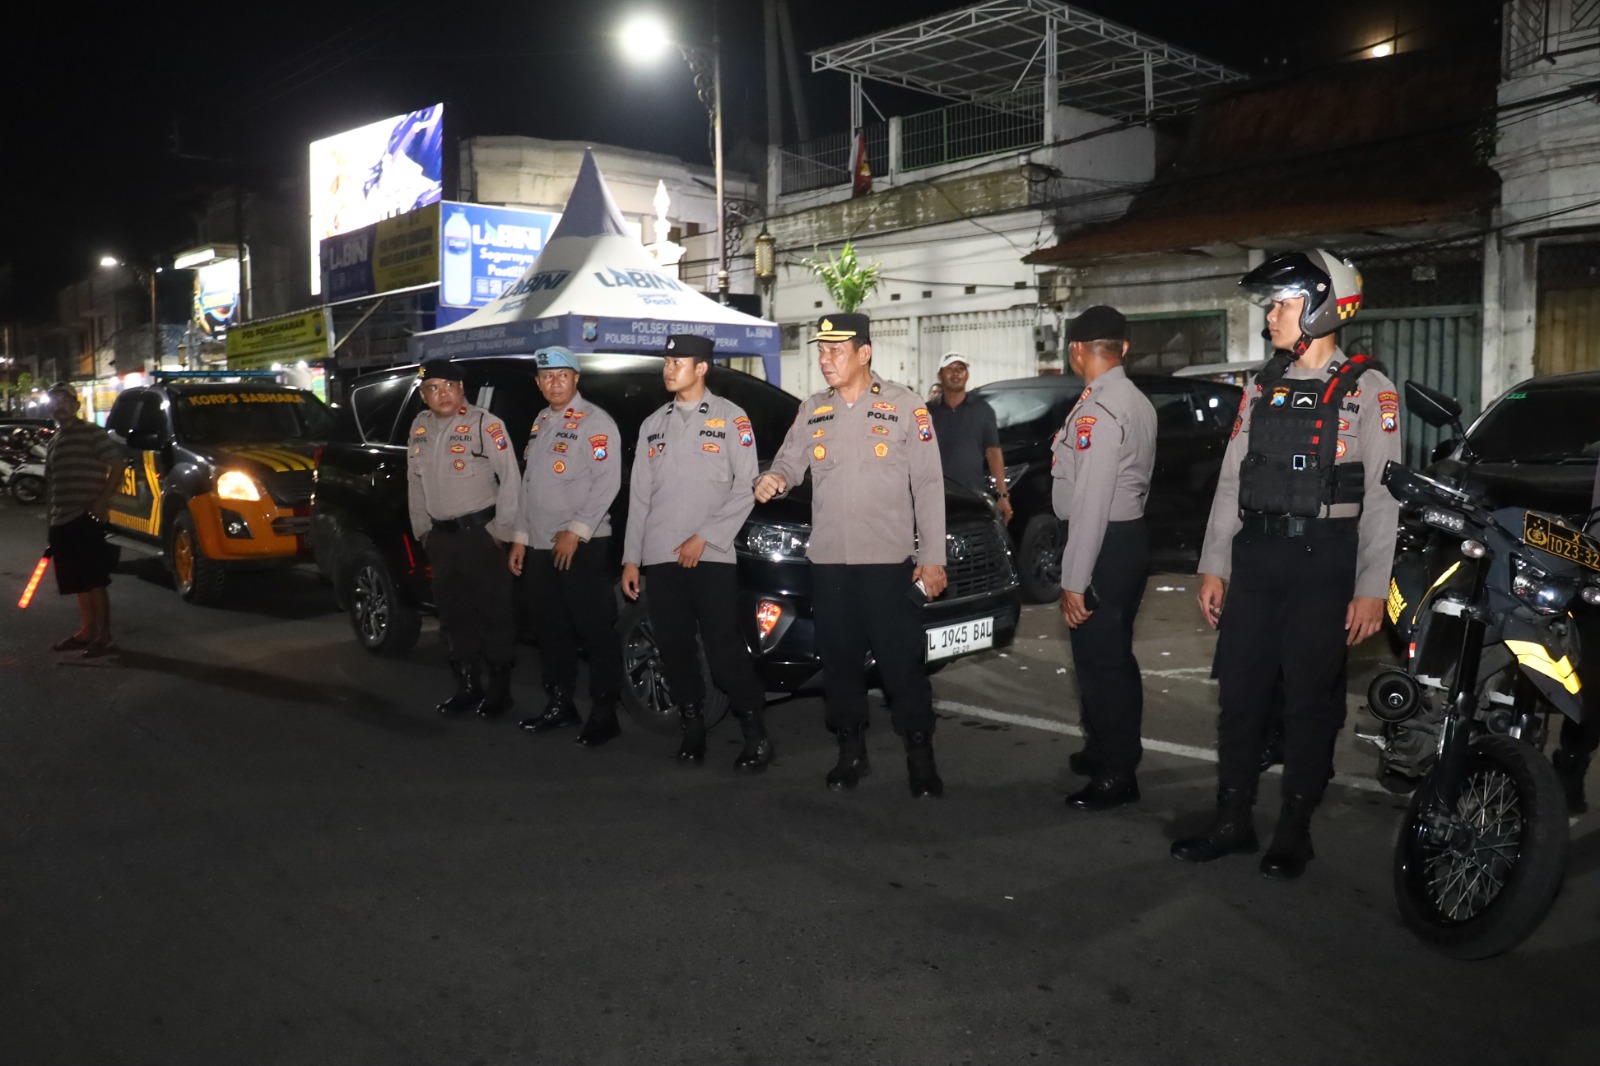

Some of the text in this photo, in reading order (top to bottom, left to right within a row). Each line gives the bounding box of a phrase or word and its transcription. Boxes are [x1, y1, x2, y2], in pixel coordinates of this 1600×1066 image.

[594, 266, 683, 292] LABINI
[632, 321, 715, 336] POLSEK SEMAMPIR
[605, 333, 739, 347] POLRES PELABU PERAK
[188, 392, 305, 406] KORPS SABHARA
[866, 411, 898, 422] POLRI
[556, 432, 579, 441] POLRI
[699, 430, 726, 439] POLRI
[929, 621, 992, 651] L 1945 BAL
